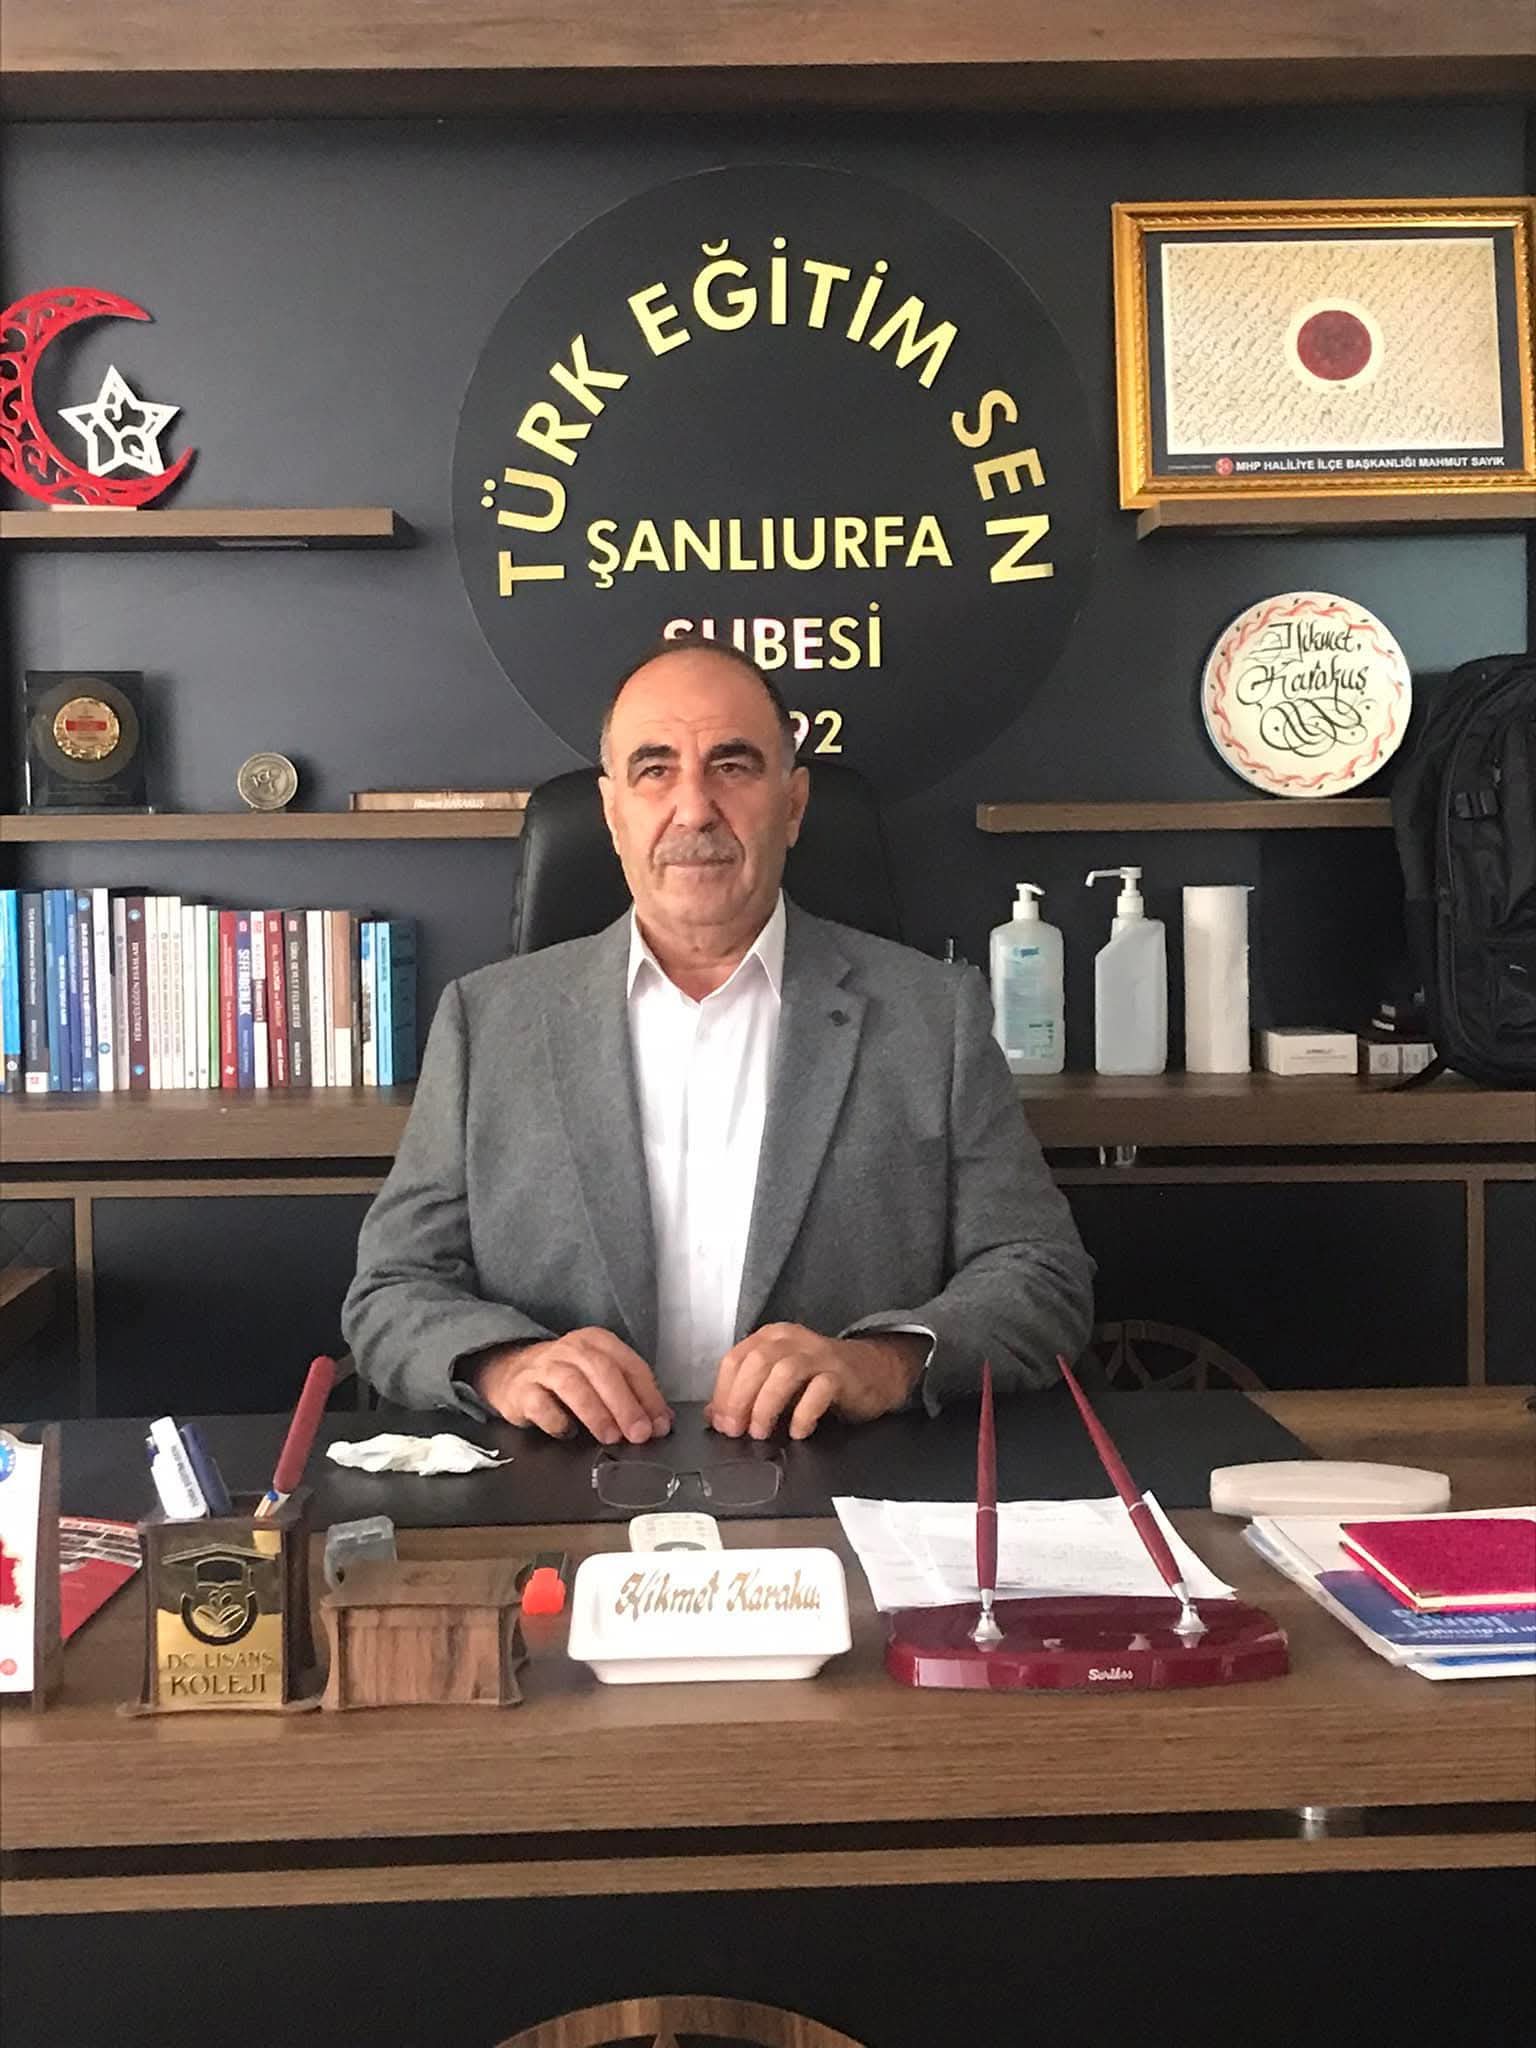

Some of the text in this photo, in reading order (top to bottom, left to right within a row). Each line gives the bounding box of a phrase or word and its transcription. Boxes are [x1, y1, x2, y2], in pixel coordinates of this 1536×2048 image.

[481, 236, 1055, 597] TÜRK EĞİTİM SEN
[1235, 456, 1505, 471] MHP HALİLİYE İLÇE BAŞKANLIĞI MAHMUT SAYIK
[586, 514, 953, 589] ŞANLIURFA
[615, 1569, 720, 1622] Hikmet
